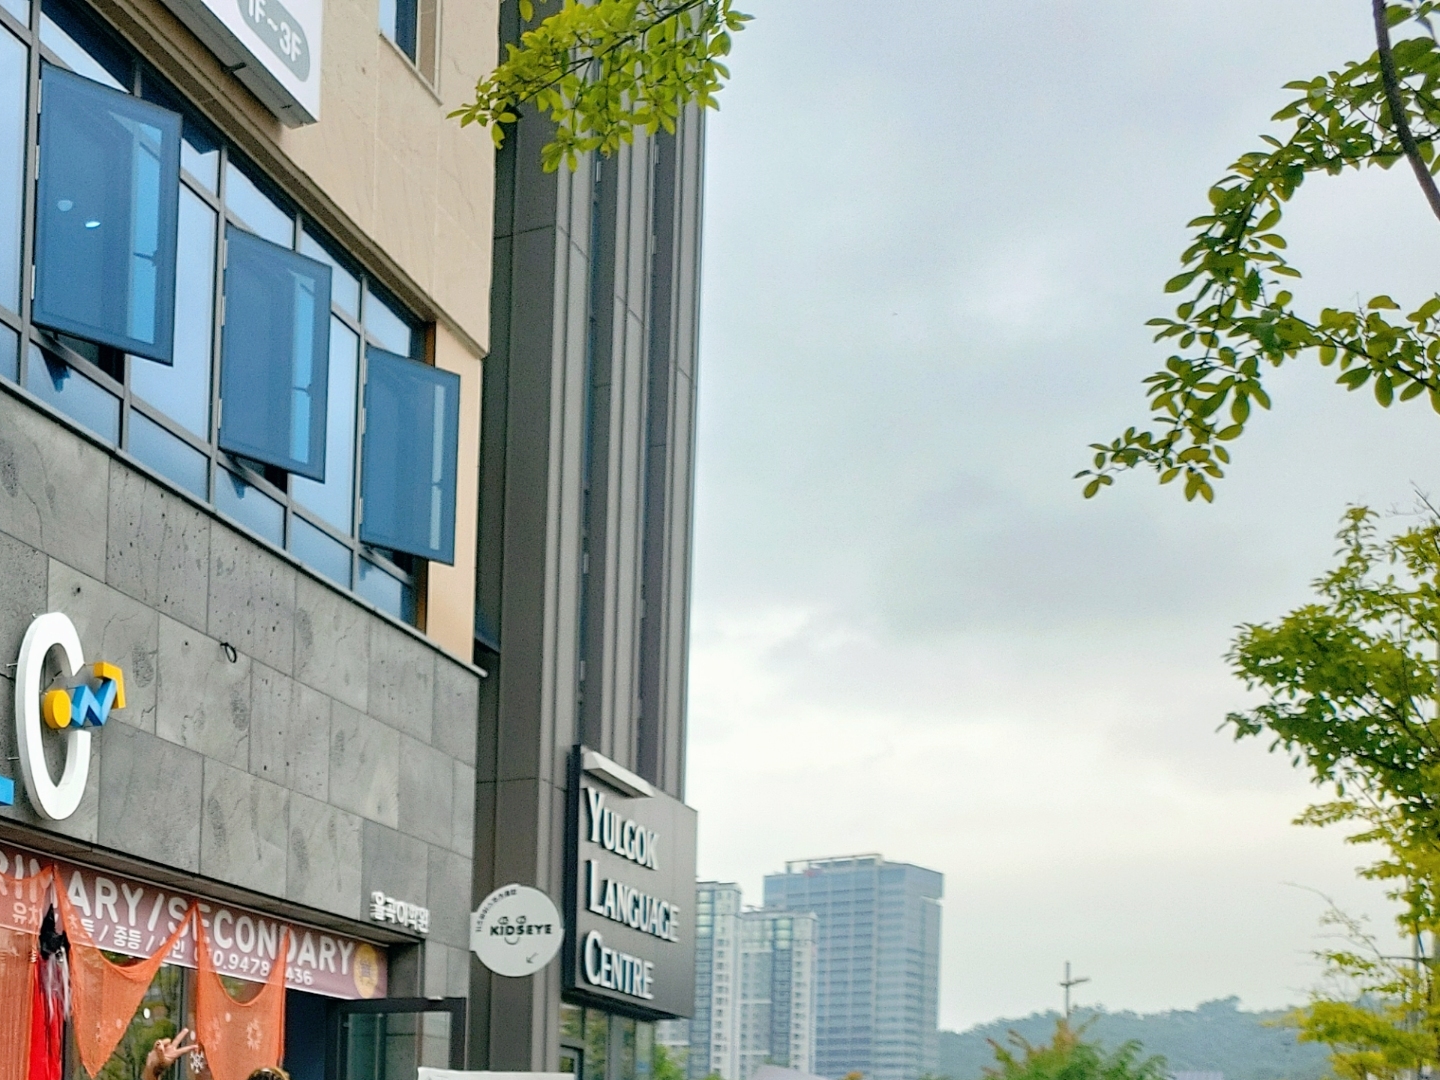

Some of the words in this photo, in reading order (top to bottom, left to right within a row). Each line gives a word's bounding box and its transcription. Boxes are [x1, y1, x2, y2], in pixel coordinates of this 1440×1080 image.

[585, 787, 660, 870] YULGOK
[490, 923, 552, 936] KIDSEYE
[586, 859, 681, 943] LANGUAGE
[584, 930, 655, 1000] CENTRE
